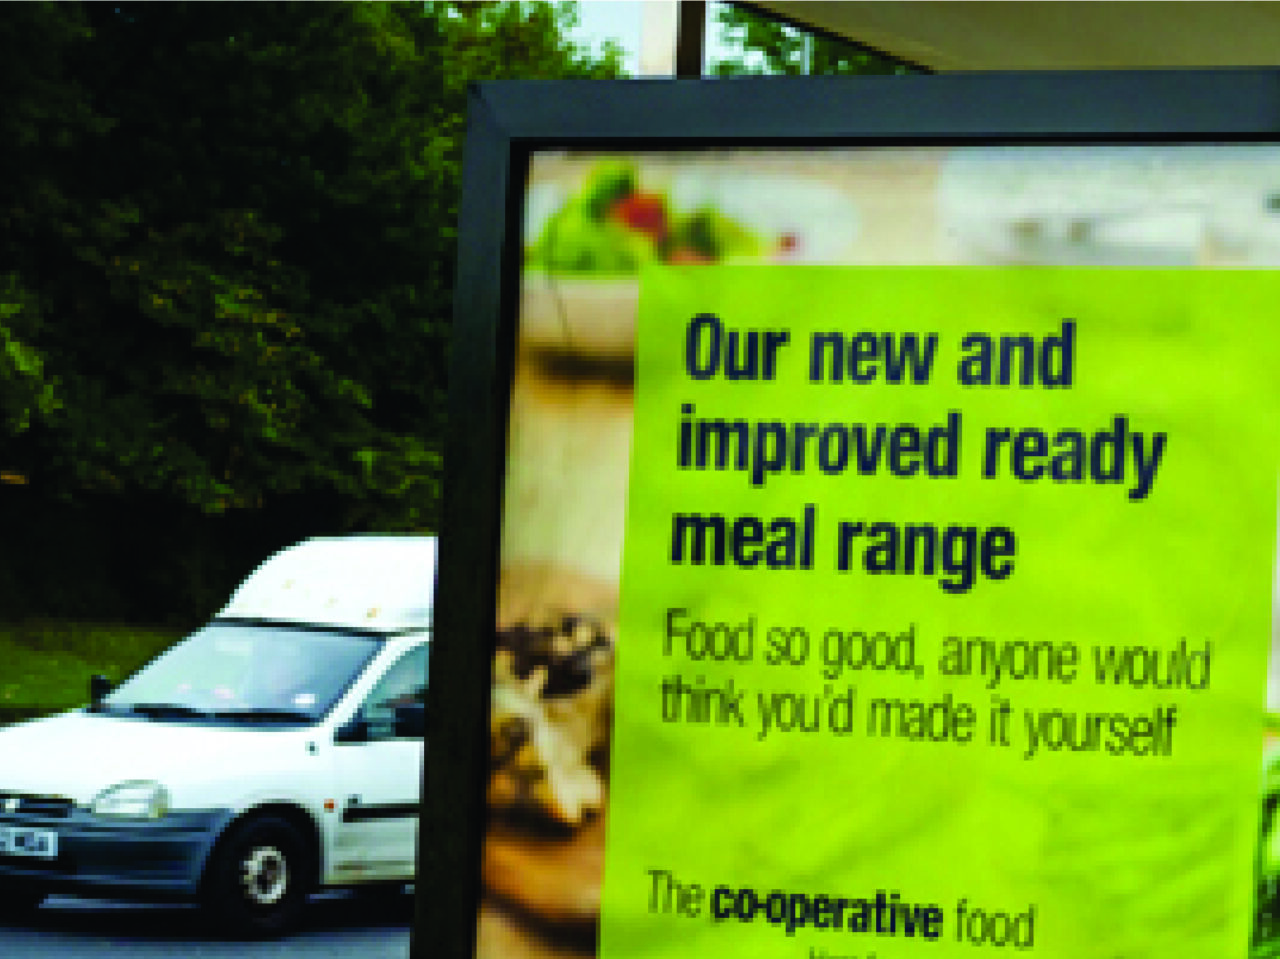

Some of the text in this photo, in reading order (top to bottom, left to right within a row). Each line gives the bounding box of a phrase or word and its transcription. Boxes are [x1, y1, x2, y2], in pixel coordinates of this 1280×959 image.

[685, 313, 1077, 389] Our new and
[677, 403, 1168, 502] improved ready
[669, 503, 1016, 594] meal range
[662, 607, 1212, 690] Food so good, anyone would
[660, 675, 1177, 760] think you'd made it yourself
[647, 869, 1037, 950] The co-operative food
